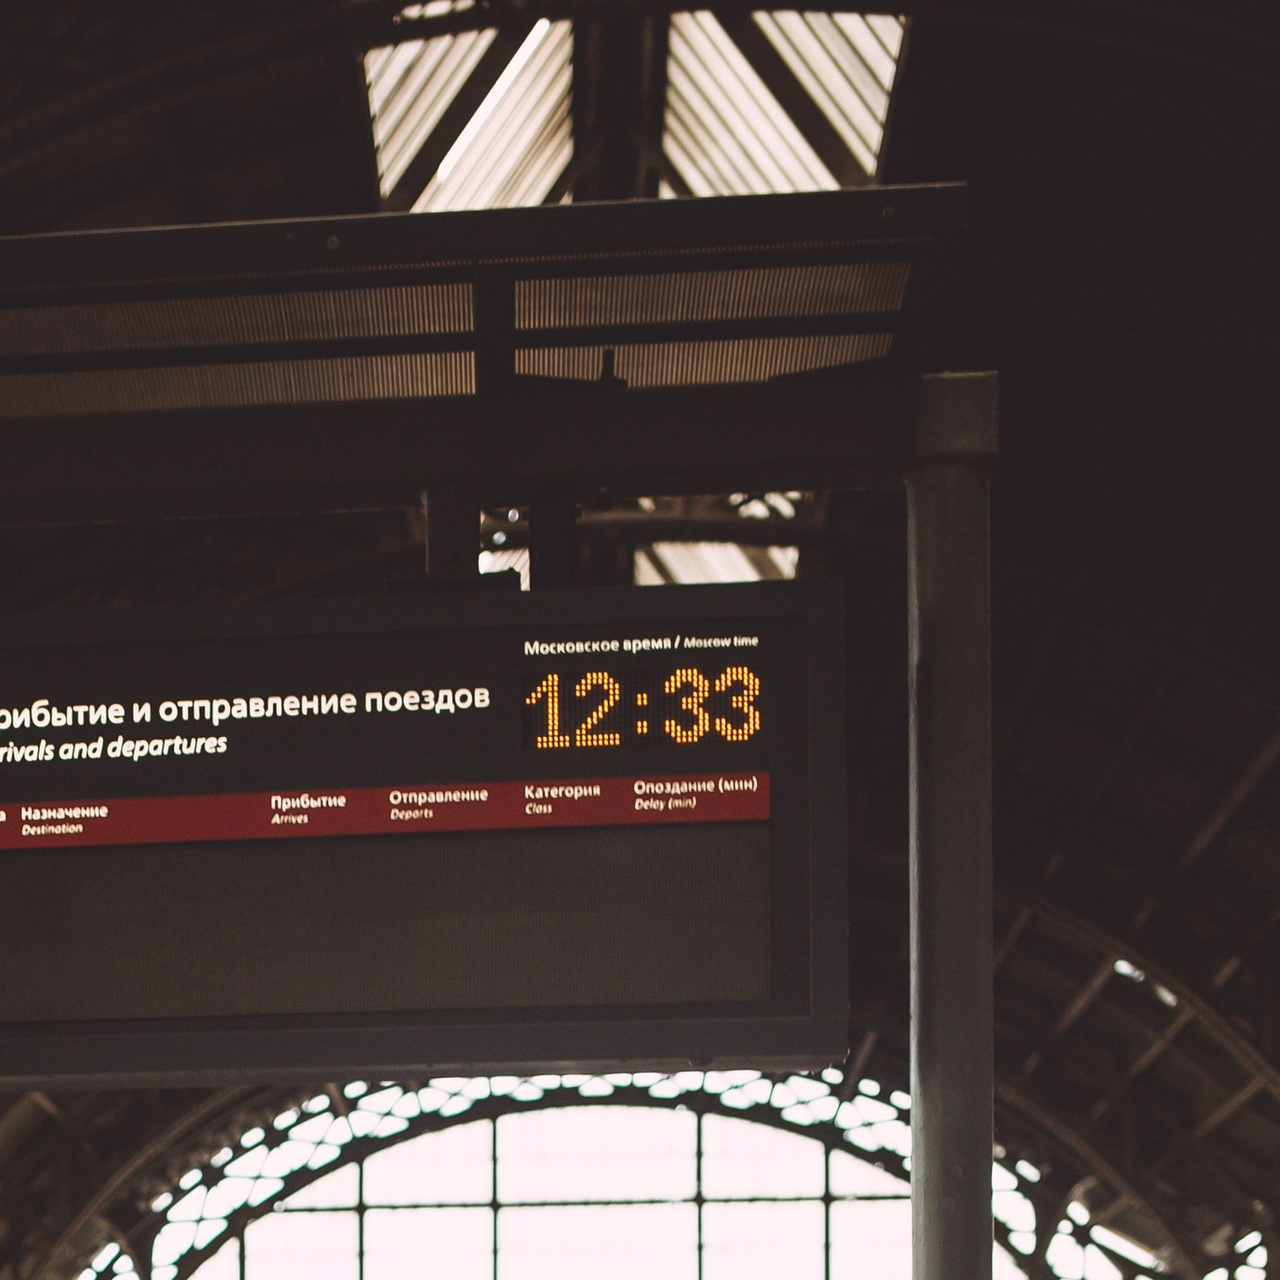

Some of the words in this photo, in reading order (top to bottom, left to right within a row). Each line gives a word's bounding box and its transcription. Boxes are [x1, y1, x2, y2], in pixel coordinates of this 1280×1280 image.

[524, 639, 620, 656] Московское
[623, 637, 672, 655] время
[684, 636, 731, 649] Moscow
[733, 634, 759, 648] time
[132, 702, 151, 723] и
[158, 692, 358, 727] отправление
[364, 687, 491, 715] поездов
[525, 666, 760, 749] 12:33
[58, 736, 104, 760] and
[106, 735, 228, 762] departures
[524, 784, 601, 800] Категория
[633, 779, 716, 796] Опоздание
[718, 775, 758, 794] (мин)
[270, 793, 347, 812] Прибытие
[389, 788, 489, 806] Отправление
[634, 797, 665, 811] Delay
[668, 795, 697, 809] (min)
[21, 805, 109, 821] Назначение
[390, 807, 434, 821] Departs
[525, 802, 553, 815] Class
[271, 812, 309, 825] Arrives
[21, 822, 84, 836] Destination
